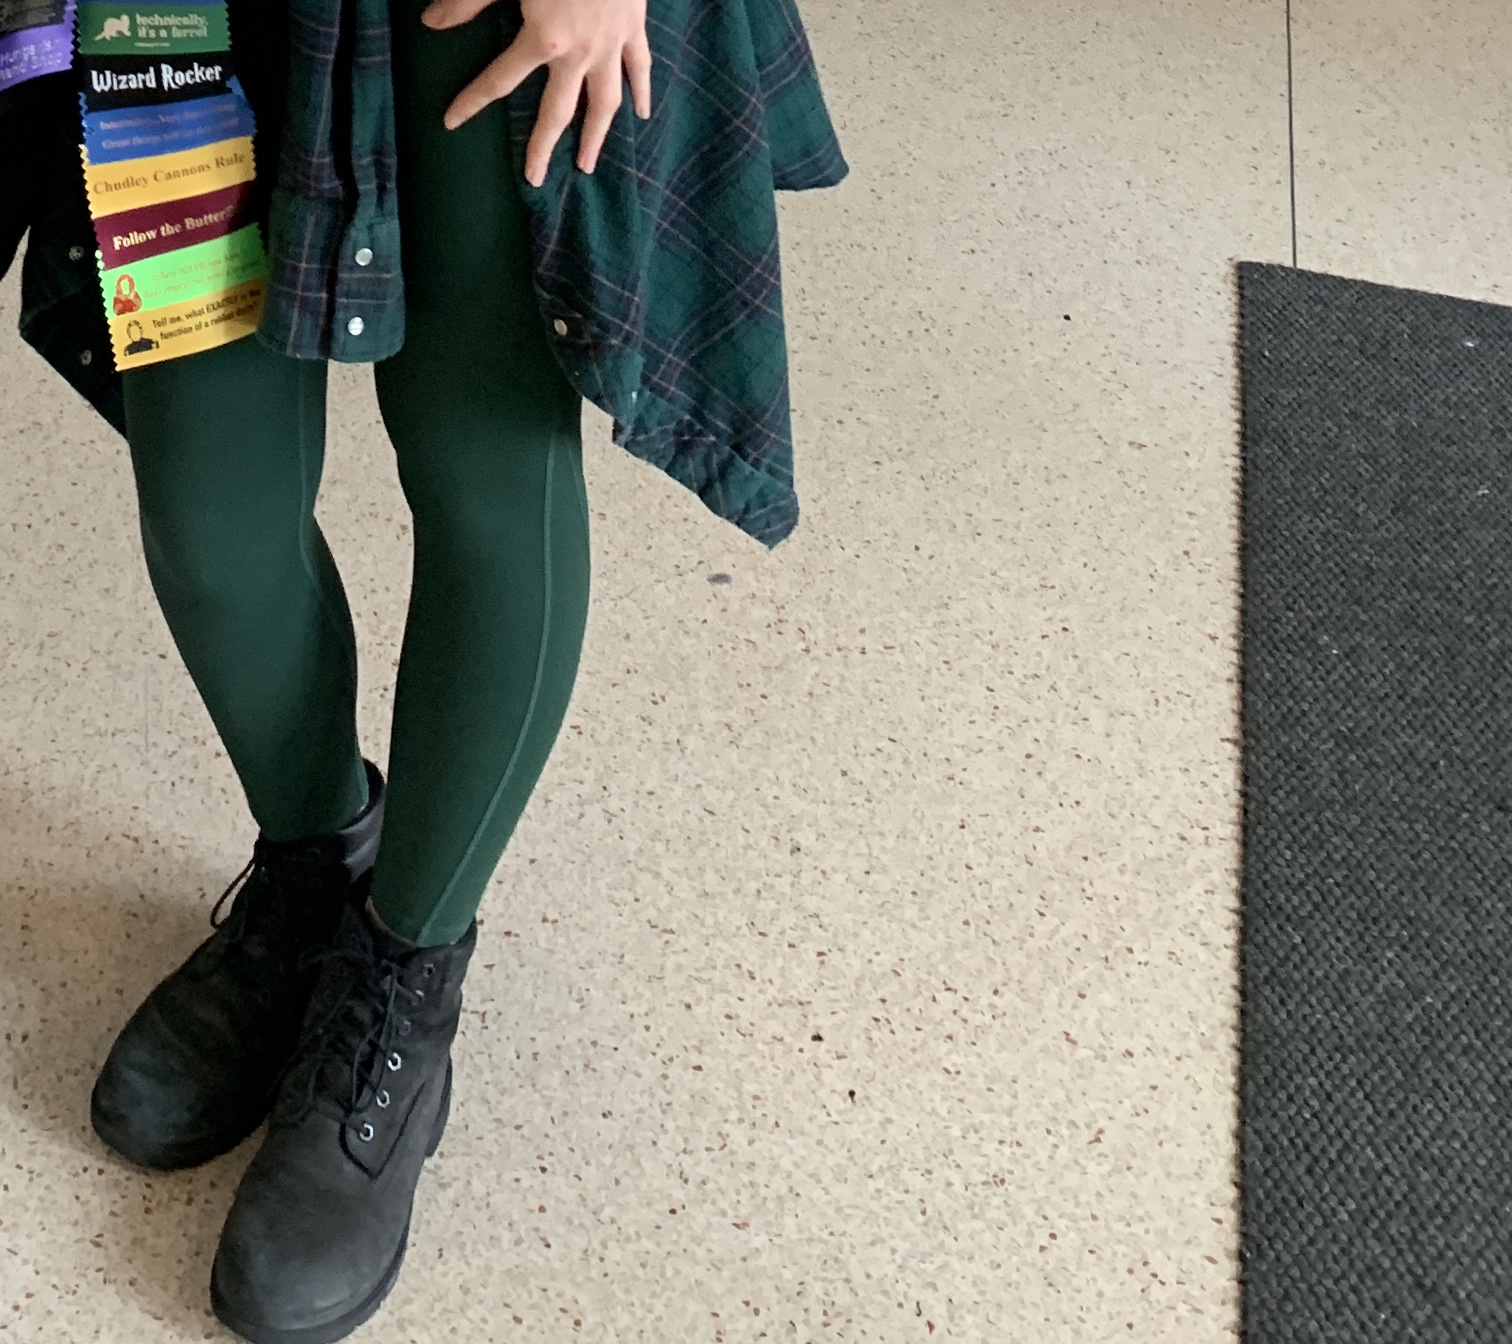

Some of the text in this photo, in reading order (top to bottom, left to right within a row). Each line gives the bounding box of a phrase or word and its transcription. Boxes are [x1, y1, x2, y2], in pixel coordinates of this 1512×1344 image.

[90, 61, 223, 94] Wizard Rocker
[92, 152, 246, 195] Chudley Cannons Rule
[112, 229, 158, 252] Follow
[159, 222, 182, 237] the
[151, 316, 168, 329] Tell
[184, 307, 206, 322] what
